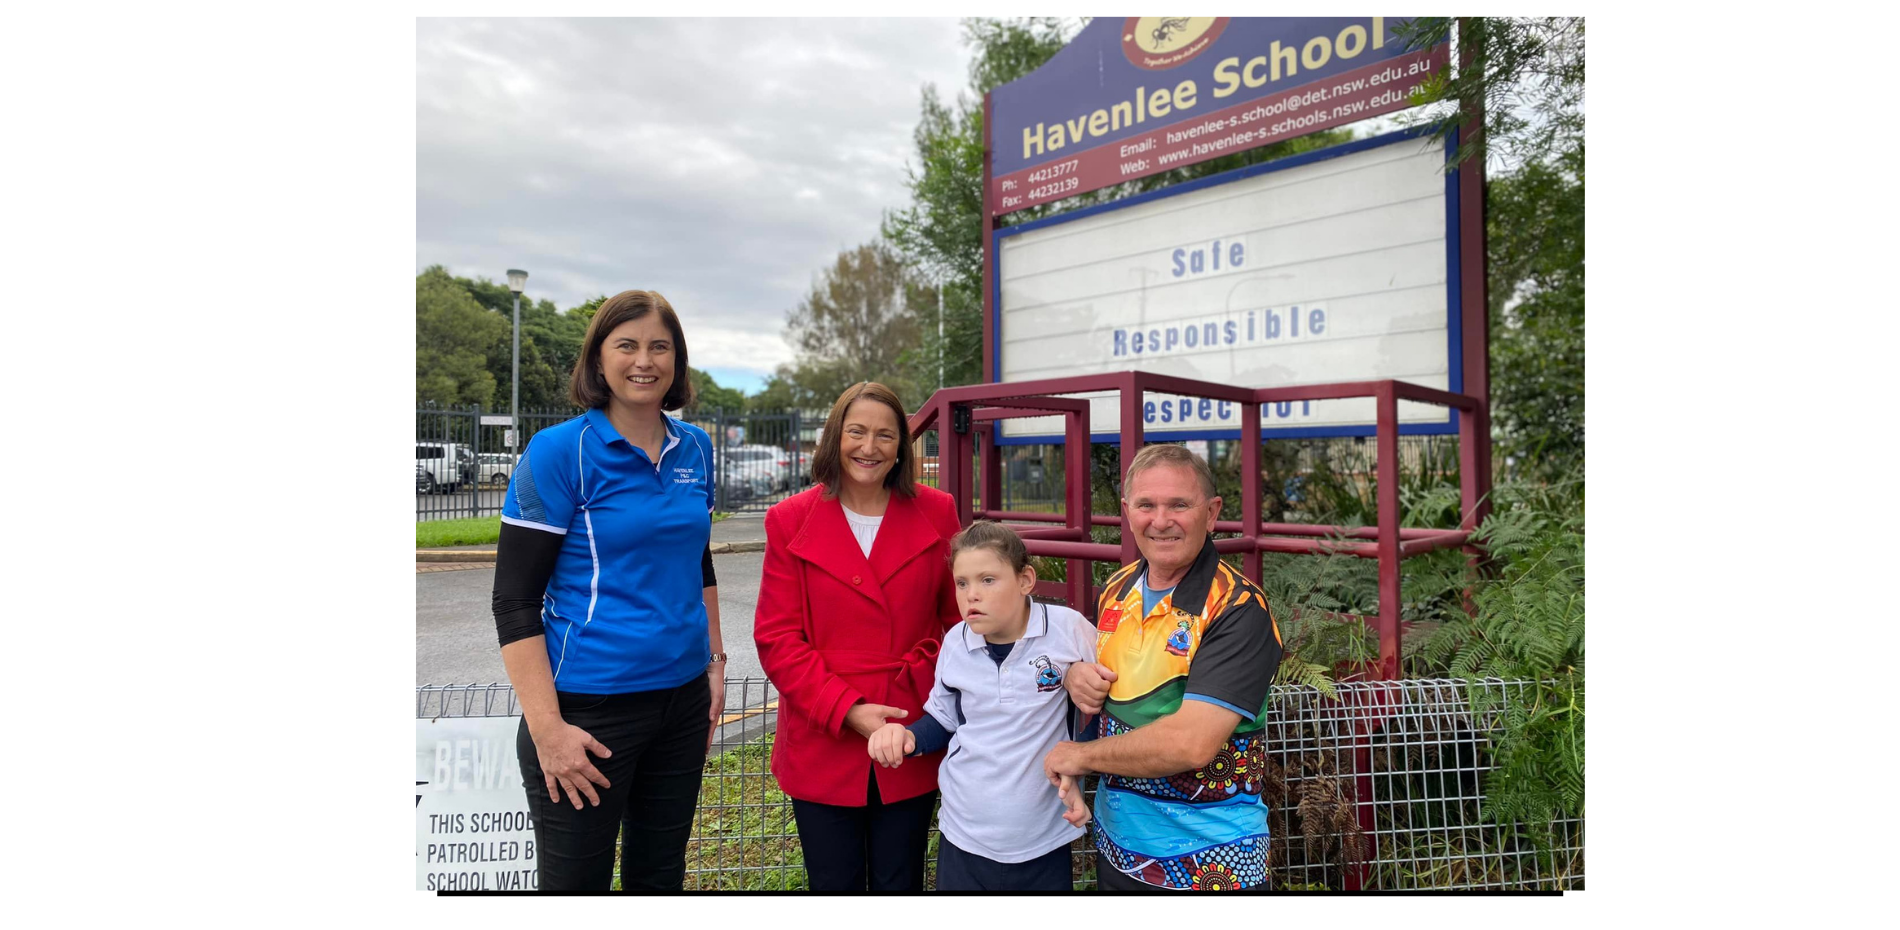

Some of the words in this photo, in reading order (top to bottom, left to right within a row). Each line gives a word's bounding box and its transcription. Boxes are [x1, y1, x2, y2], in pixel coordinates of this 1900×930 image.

[1022, 79, 1197, 159] Havenlee
[1213, 17, 1384, 98] School
[1120, 138, 1156, 158] Email:
[1166, 59, 1430, 145] havenlee-s.school@det.nsw.edu.au
[1002, 179, 1018, 192] Ph:
[1027, 160, 1079, 184] 44213777
[1120, 160, 1150, 176] Web:
[1002, 194, 1022, 209] Fax:
[1027, 178, 1079, 200] 44232139
[1172, 240, 1245, 278] Safe
[1113, 306, 1325, 357] Responsible
[434, 738, 521, 792] BEWA
[429, 813, 465, 834] THIS
[470, 811, 535, 833] SCHOOL
[427, 841, 519, 863] PATROLLED
[525, 840, 536, 860] B
[427, 871, 490, 891] SCHOOL
[496, 869, 539, 891] WATC
